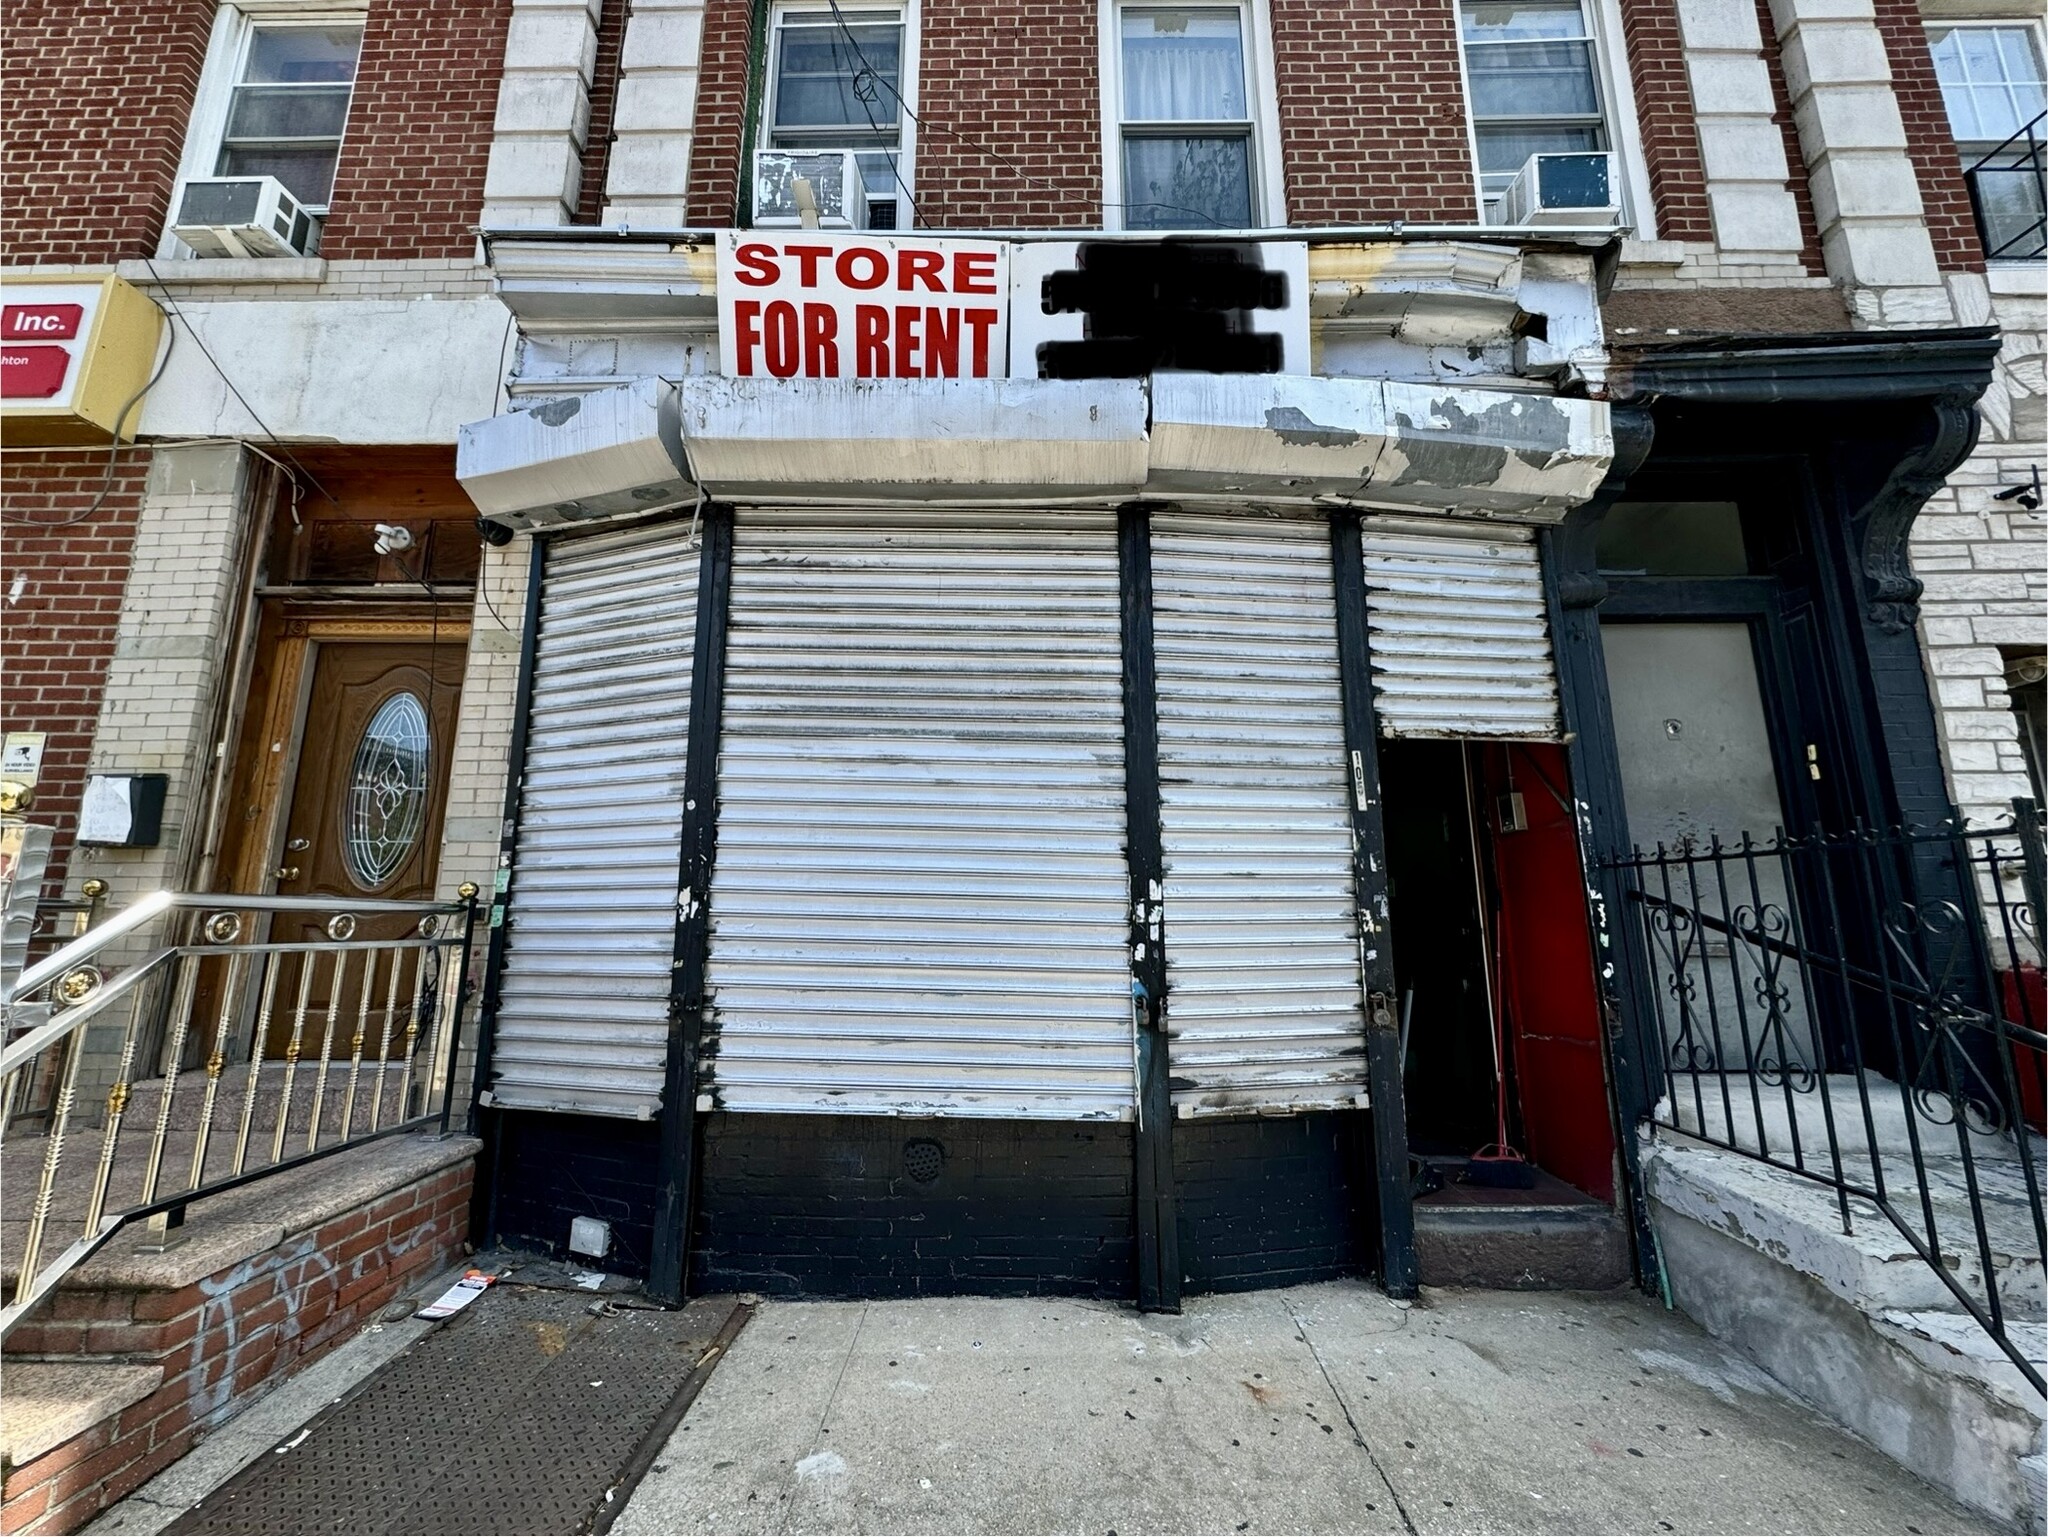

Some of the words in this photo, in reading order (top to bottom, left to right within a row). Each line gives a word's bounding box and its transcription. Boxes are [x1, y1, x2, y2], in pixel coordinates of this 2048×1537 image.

[734, 243, 998, 295] STORE
[14, 311, 66, 331] Inc.
[734, 299, 840, 379] FOR
[855, 303, 998, 379] RENT
